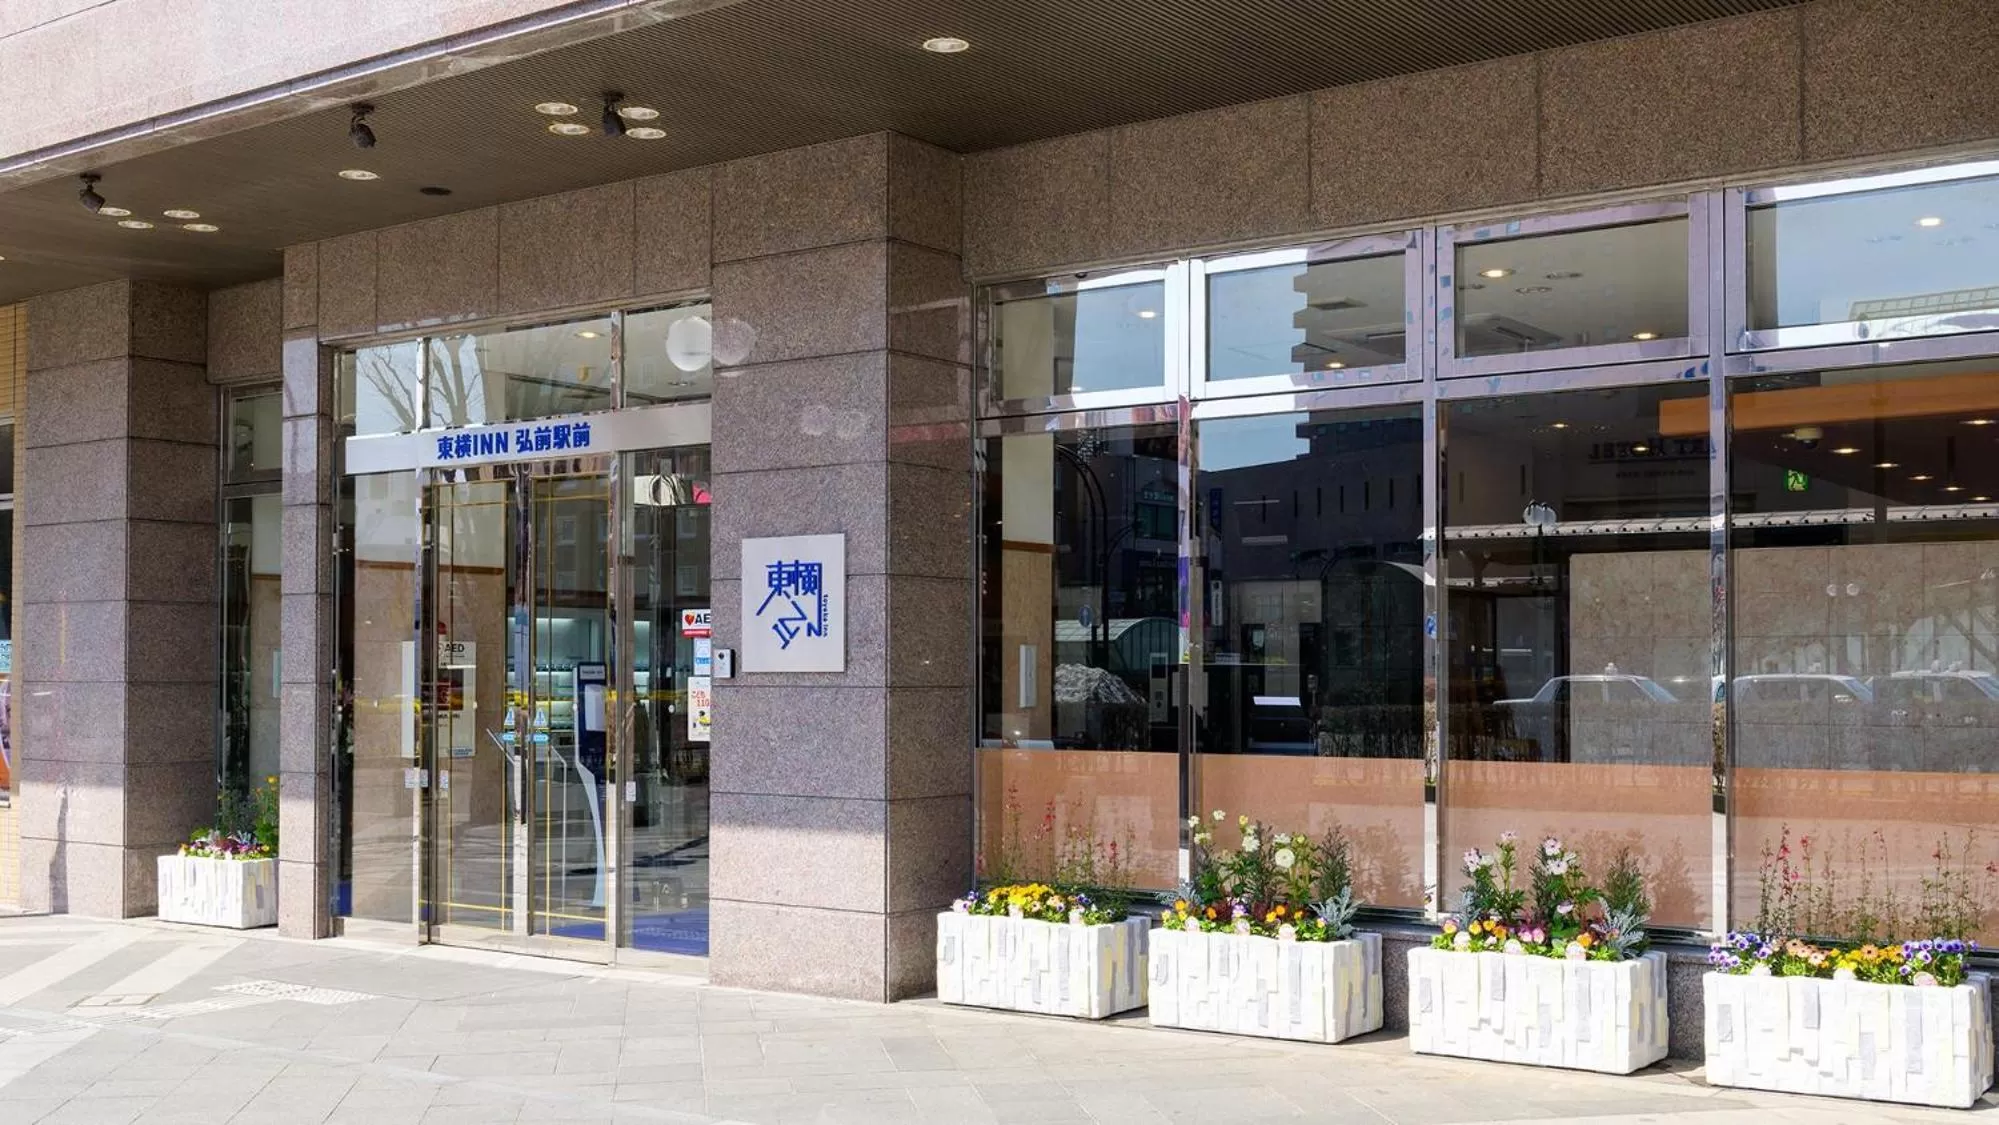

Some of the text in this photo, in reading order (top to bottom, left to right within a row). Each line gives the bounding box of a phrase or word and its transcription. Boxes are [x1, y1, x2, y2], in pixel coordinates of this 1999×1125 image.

[437, 421, 591, 460] 東横INN 弘前駅前
[444, 643, 465, 653] AED
